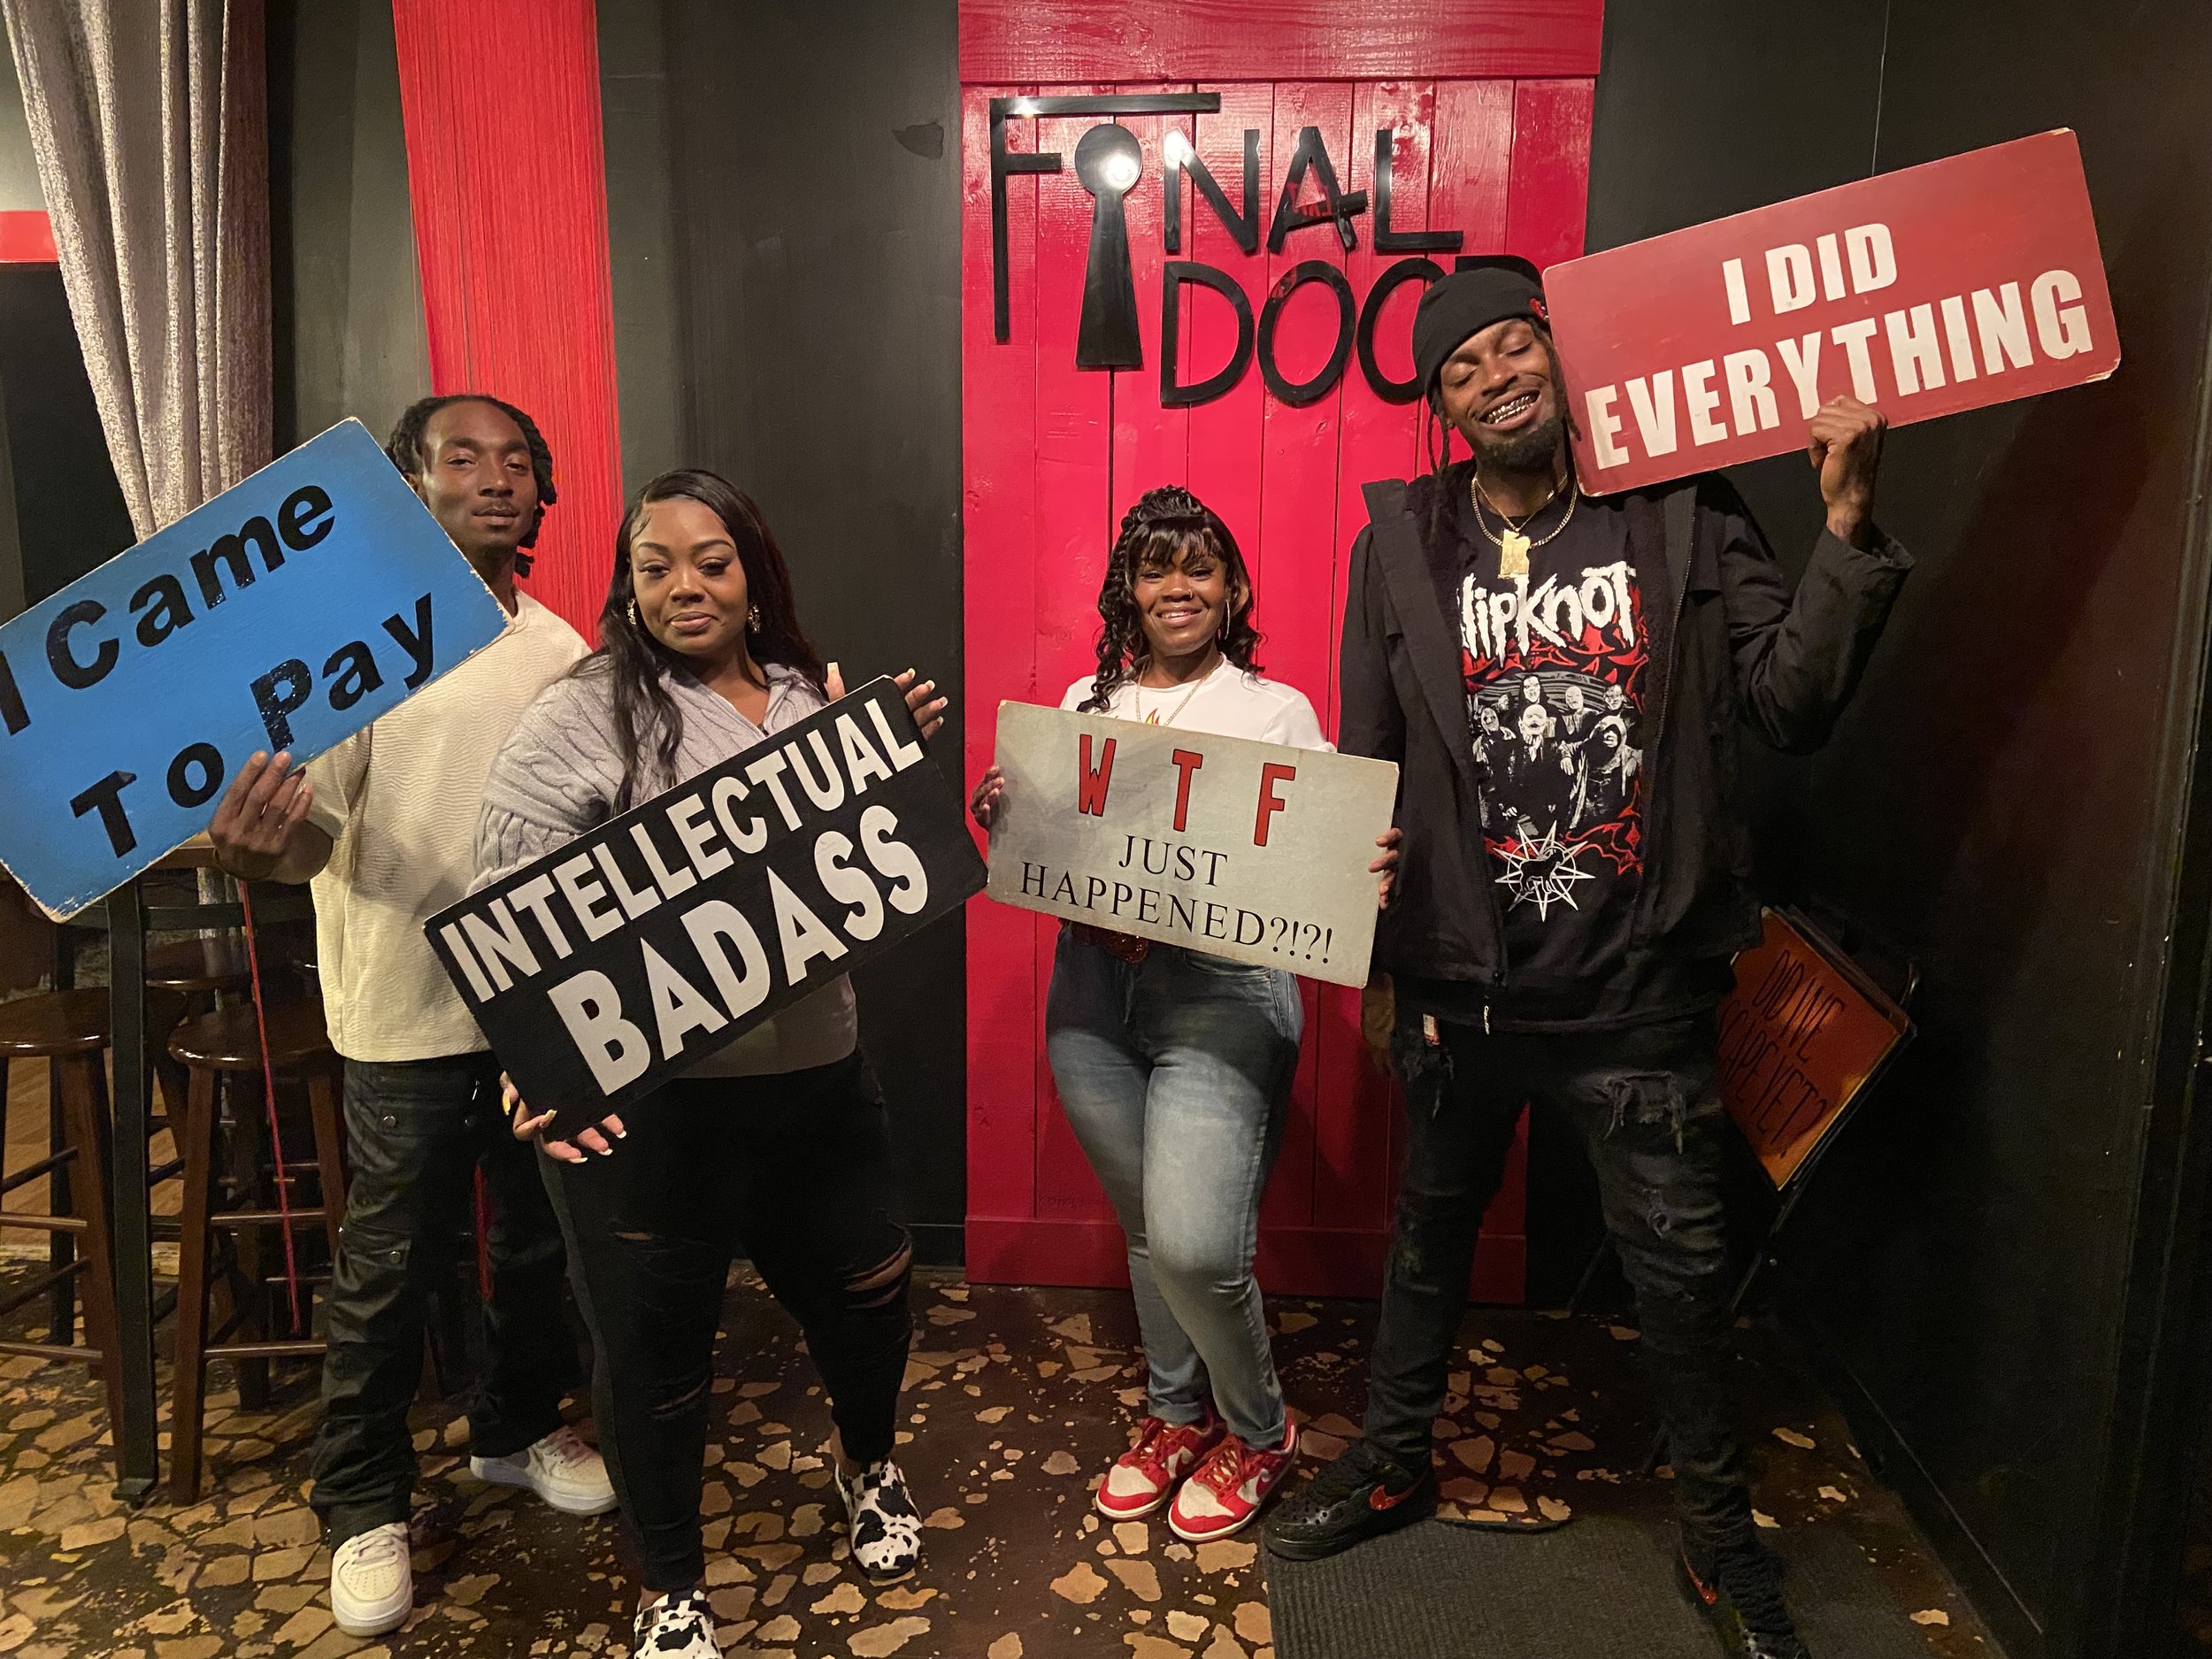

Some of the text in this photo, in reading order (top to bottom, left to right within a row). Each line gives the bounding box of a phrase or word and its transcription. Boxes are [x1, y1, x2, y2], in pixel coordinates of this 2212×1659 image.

[1160, 254, 1544, 407] DOO
[1584, 269, 2093, 470] EVERYTHING
[1722, 223, 1898, 326] I DID
[45, 485, 336, 690] Came
[70, 592, 435, 859] To Pay
[440, 697, 925, 1003] INTELLECTUAL
[547, 804, 929, 1097] BADASS
[1018, 861, 1333, 964] HAPPENED?!?!
[1118, 833, 1229, 887] JUST
